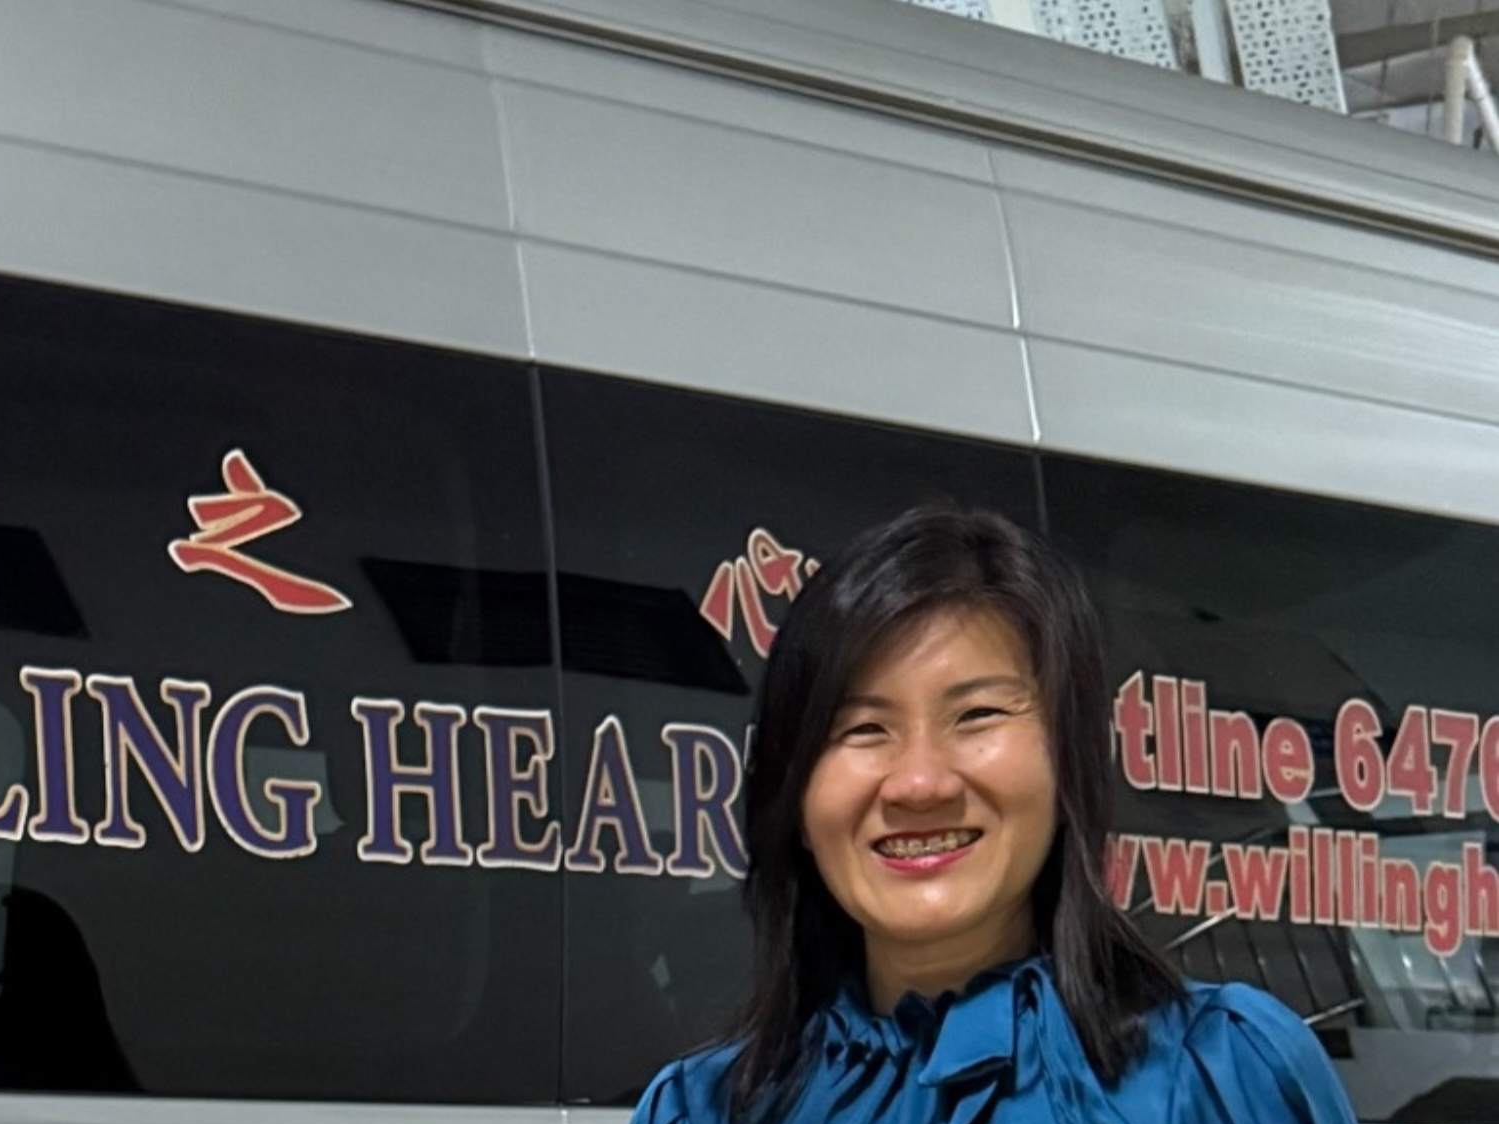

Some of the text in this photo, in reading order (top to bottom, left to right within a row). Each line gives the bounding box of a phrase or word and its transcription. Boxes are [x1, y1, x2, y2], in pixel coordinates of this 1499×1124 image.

[167, 449, 353, 613] 之
[352, 696, 756, 878] HEAR
[1109, 669, 1314, 803] tline
